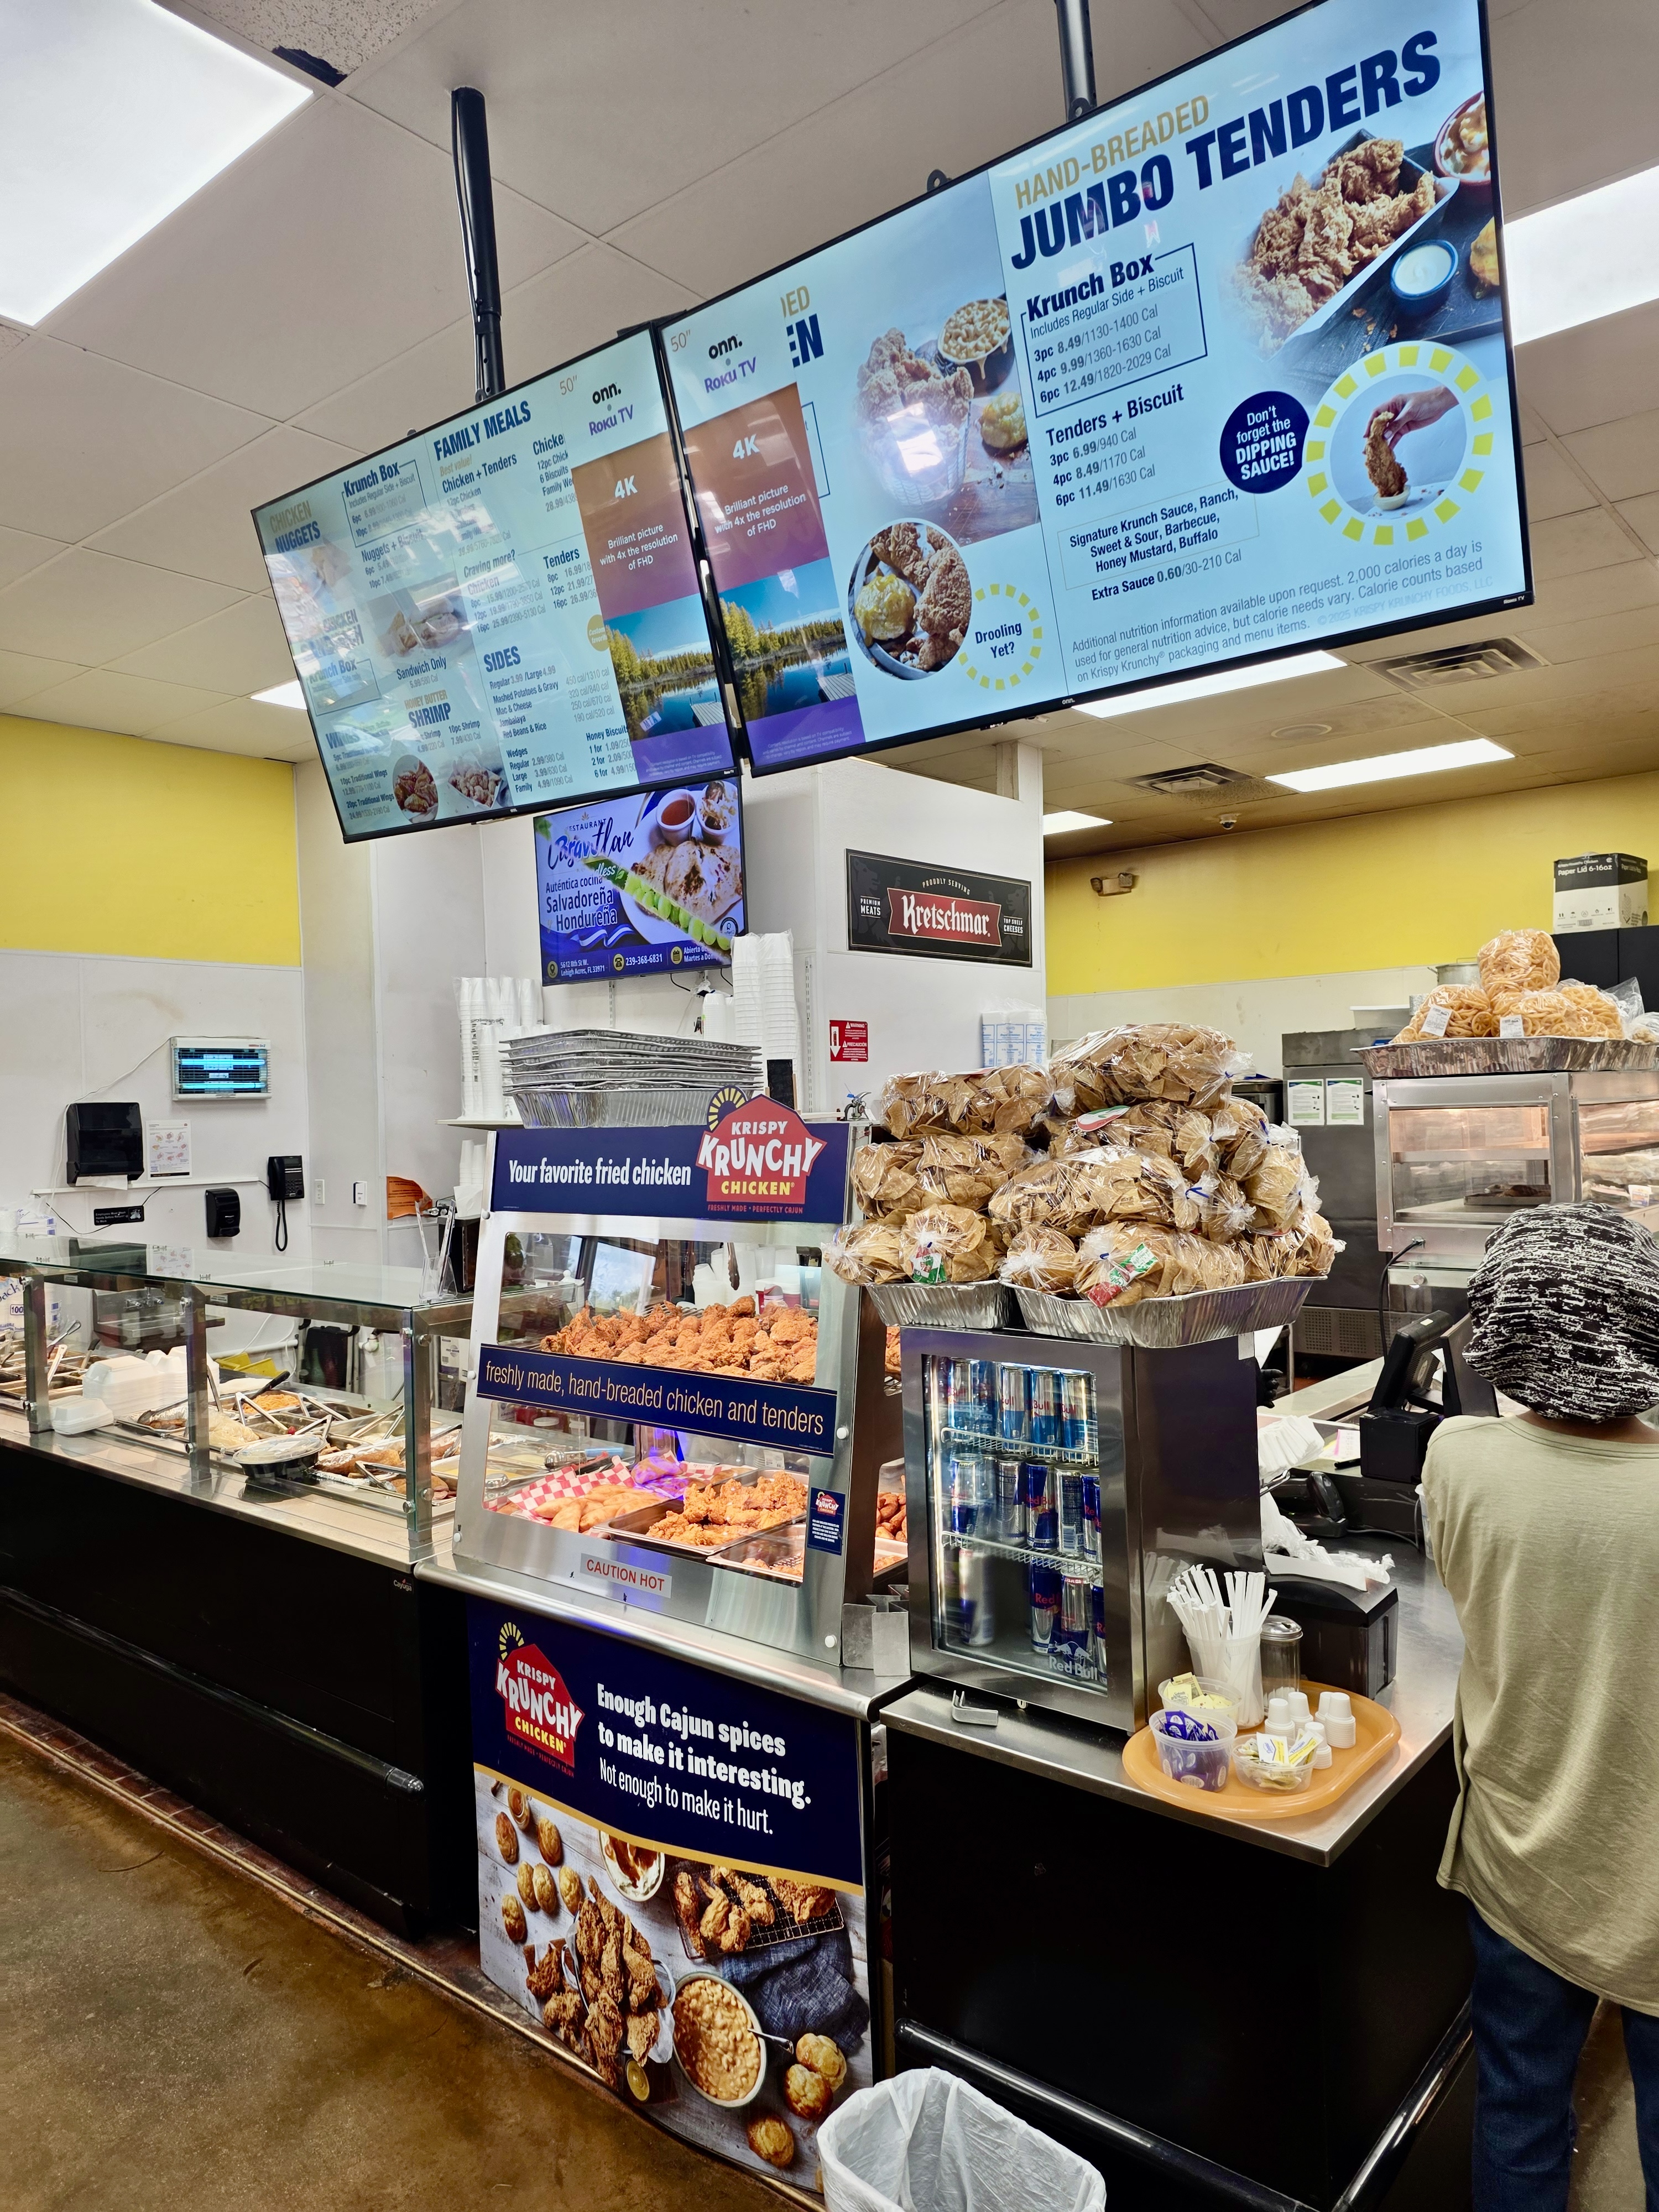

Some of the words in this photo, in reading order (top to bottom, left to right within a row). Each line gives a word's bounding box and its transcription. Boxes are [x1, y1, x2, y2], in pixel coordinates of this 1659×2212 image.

[1011, 153, 1175, 270] JUMBO
[1185, 30, 1441, 191] TENDERS
[1014, 95, 1210, 210] HAND-BREADED
[1026, 272, 1104, 322] Krunch
[1109, 253, 1155, 288] Box
[1030, 313, 1070, 339] Includes
[1073, 299, 1109, 324] Regular
[1112, 289, 1134, 306] Side
[1138, 286, 1145, 295] +
[1148, 267, 1184, 292] Biscuit
[1034, 346, 1054, 362] 3pc
[1141, 304, 1158, 320] Cal
[738, 356, 757, 379] TV
[1037, 367, 1057, 383] 4pc
[1144, 326, 1161, 342] Cal
[1040, 388, 1060, 403] 6pc
[1155, 343, 1171, 360] Cal
[434, 421, 481, 461] FAMILY
[483, 400, 531, 439] MEALS
[1046, 414, 1107, 446] Tenders
[1112, 410, 1122, 423] +
[1127, 383, 1185, 419] Biscuit
[1247, 405, 1277, 426] Don't
[733, 434, 760, 460] 4K
[1050, 451, 1069, 466] 3pc
[1072, 434, 1118, 459] 6.99/940
[1121, 427, 1137, 441] Cal
[1235, 432, 1296, 464] DIPPING
[1237, 423, 1271, 444] forget
[1272, 419, 1291, 432] the
[343, 470, 379, 498] Krunch
[379, 462, 400, 482] Box
[442, 472, 474, 493] Chicken
[476, 470, 481, 479] +
[482, 453, 517, 477] Tenders
[1053, 471, 1072, 486] 4pc
[1076, 452, 1127, 479] 8.49/1170
[1130, 446, 1145, 461] Cal
[1240, 450, 1295, 480] SAUCE!
[1056, 491, 1075, 506] 6pc
[1078, 471, 1137, 499] 11.49/1630
[1139, 464, 1155, 479] Cal
[1070, 526, 1118, 549] Signature
[1120, 512, 1157, 531] Krunch
[1160, 500, 1197, 520] Sauce,
[1200, 487, 1238, 509] Ranch,
[275, 521, 321, 554] NUGGETS
[1091, 539, 1122, 558] Sweet
[1124, 537, 1132, 547] &
[1135, 529, 1162, 548] Sour,
[1165, 512, 1219, 536] Barbecue,
[1096, 552, 1127, 572] Honey
[1129, 539, 1176, 563] Mustard,
[1179, 528, 1218, 549] Buffalo
[1092, 583, 1119, 601] Extra
[1122, 575, 1155, 592] Sauce
[1157, 555, 1222, 583] 0.60/30-210
[1225, 549, 1241, 564] Cal
[1072, 632, 1117, 653] Additional
[1119, 621, 1159, 641] nutrition
[1161, 606, 1217, 631] information
[1220, 595, 1266, 615] available
[1269, 587, 1296, 604] upon
[1299, 573, 1344, 596] request.
[1347, 564, 1381, 584] 2,000
[1384, 551, 1431, 575] calories
[1434, 551, 1442, 561] a
[1446, 545, 1468, 561] day
[1472, 540, 1483, 553] is
[975, 623, 1022, 644] Drooling
[990, 641, 1015, 659] Yet?
[397, 661, 430, 680] Sandwich
[431, 656, 446, 672] Only
[483, 646, 521, 672] SIDES
[493, 692, 514, 704] Mashed
[514, 686, 536, 698] Potatoes
[543, 681, 559, 692] Gravy
[408, 702, 451, 729] SHRIMP
[507, 748, 528, 758] Wedges
[566, 818, 606, 832] ESTAURANT
[546, 878, 578, 894] Auténtica
[546, 886, 614, 914] Salvadoreña
[860, 898, 880, 906] PREMIUM
[922, 878, 946, 888] PROUDLY
[948, 879, 971, 895] SERVING
[556, 907, 618, 932] Hondureña
[860, 906, 881, 916] MEATS
[1004, 925, 1023, 934] CHEESES
[625, 954, 662, 965] 239-368-6831
[731, 1120, 788, 1135] KRISPY
[509, 1160, 537, 1183] Your
[540, 1157, 592, 1185] favorite
[596, 1157, 629, 1185] fried
[633, 1157, 691, 1186] chicken
[698, 1134, 823, 1178] KRUNCHY
[486, 1361, 524, 1394] freshly
[528, 1371, 565, 1396] made,
[568, 1376, 662, 1409] hand-breaded
[666, 1387, 722, 1420] chicken
[728, 1399, 757, 1423] and
[761, 1405, 824, 1435] tenders
[587, 1558, 637, 1584] CAUTION
[640, 1569, 665, 1591] HOT
[516, 1660, 556, 1690] KRISPY
[1049, 1656, 1073, 1675] Red
[1074, 1662, 1098, 1680] Bull
[497, 1661, 583, 1740] KRUNCHY
[597, 1683, 656, 1727] Enough
[659, 1703, 714, 1740] Cajun
[718, 1721, 786, 1756] spices
[598, 1722, 614, 1747] to
[617, 1730, 665, 1765] make
[668, 1741, 684, 1771] it
[687, 1747, 811, 1809] interesting.
[599, 1757, 617, 1784] Not
[618, 1772, 662, 1808] enough
[665, 1783, 678, 1807] to
[682, 1790, 720, 1819] make
[723, 1799, 734, 1824] it
[737, 1798, 773, 1834] hurt.
